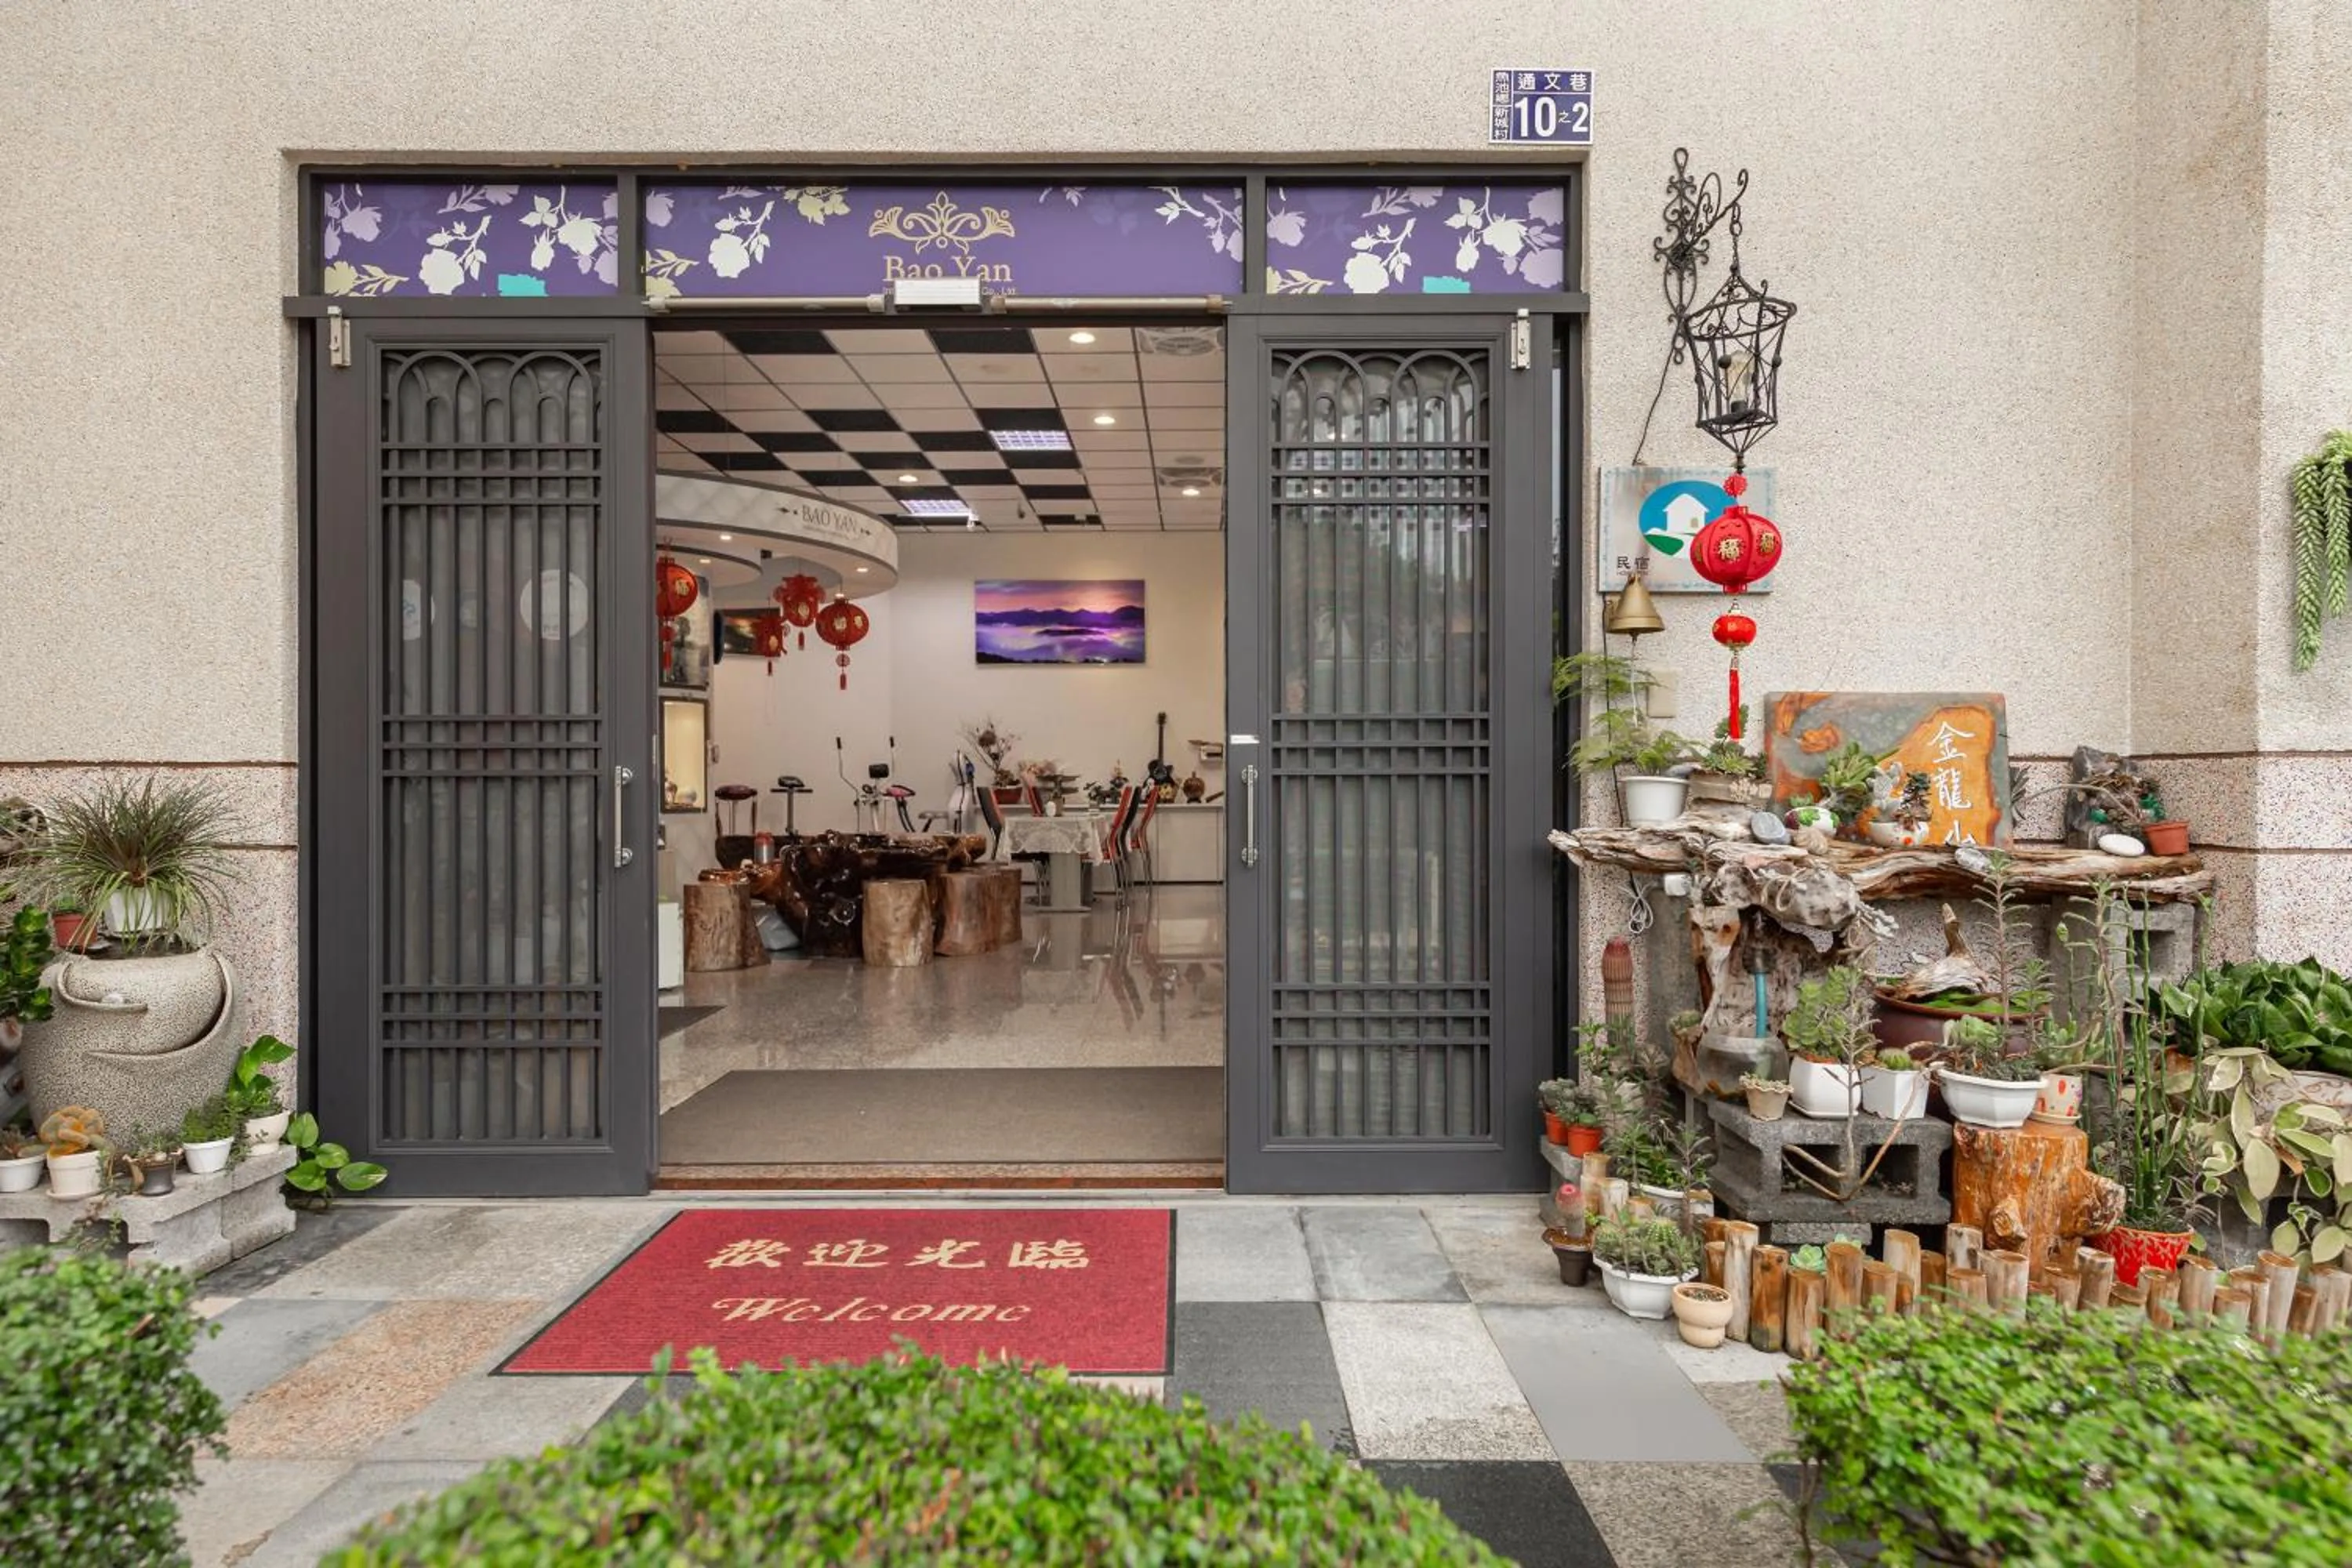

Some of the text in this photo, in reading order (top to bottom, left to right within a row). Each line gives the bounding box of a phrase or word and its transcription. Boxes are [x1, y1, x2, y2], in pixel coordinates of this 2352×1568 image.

[1517, 72, 1588, 92] 通文巷
[882, 255, 1014, 282] Bao Yan
[802, 504, 830, 526] BAO
[833, 511, 858, 533] YAN
[1617, 555, 1650, 570] 民宿
[1927, 720, 1976, 844] 金龍山
[704, 1239, 1089, 1269] 歡迎光臨
[711, 1297, 1031, 1323] Welcome
